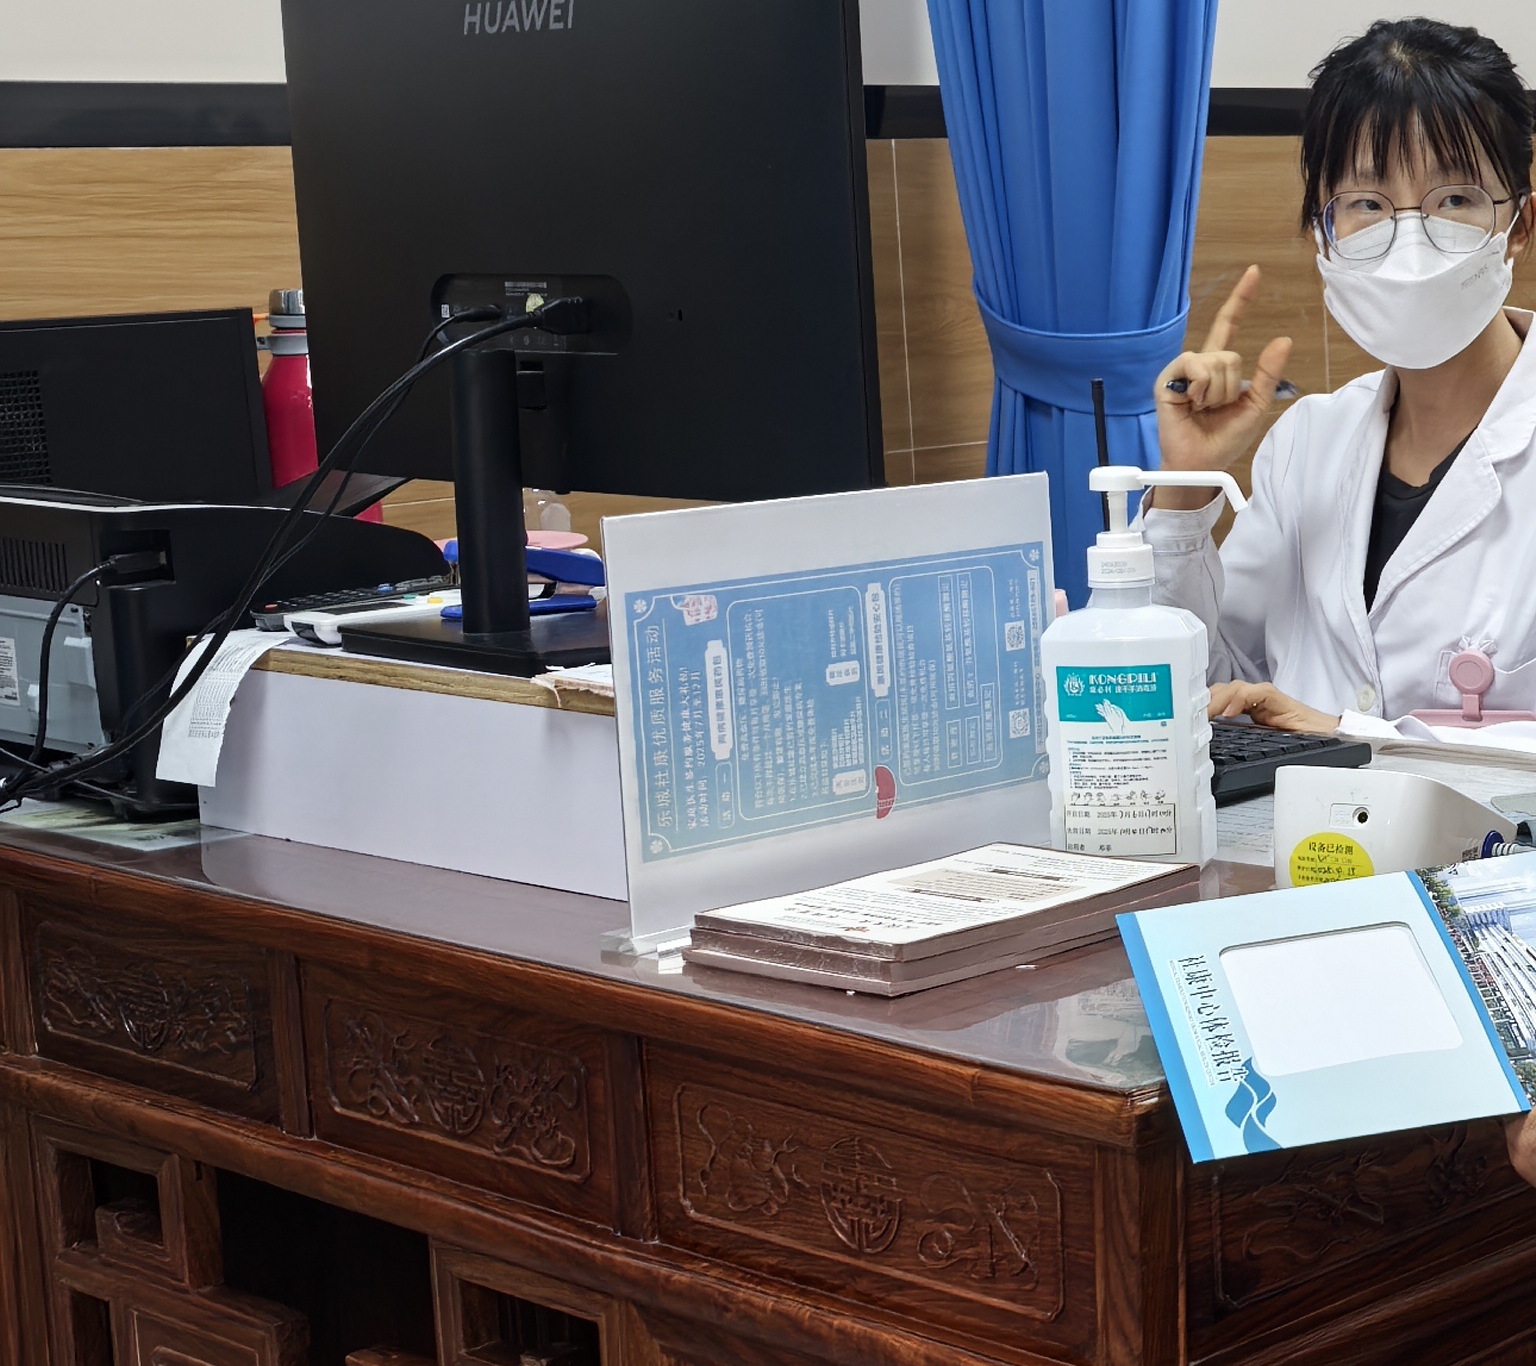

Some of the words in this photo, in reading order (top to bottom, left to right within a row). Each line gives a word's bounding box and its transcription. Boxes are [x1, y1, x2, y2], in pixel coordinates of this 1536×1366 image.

[644, 624, 672, 828] 乐城社康优质服务活动
[1309, 842, 1354, 855] 设备已检测
[1178, 955, 1248, 1082] 社康中心体检报告
